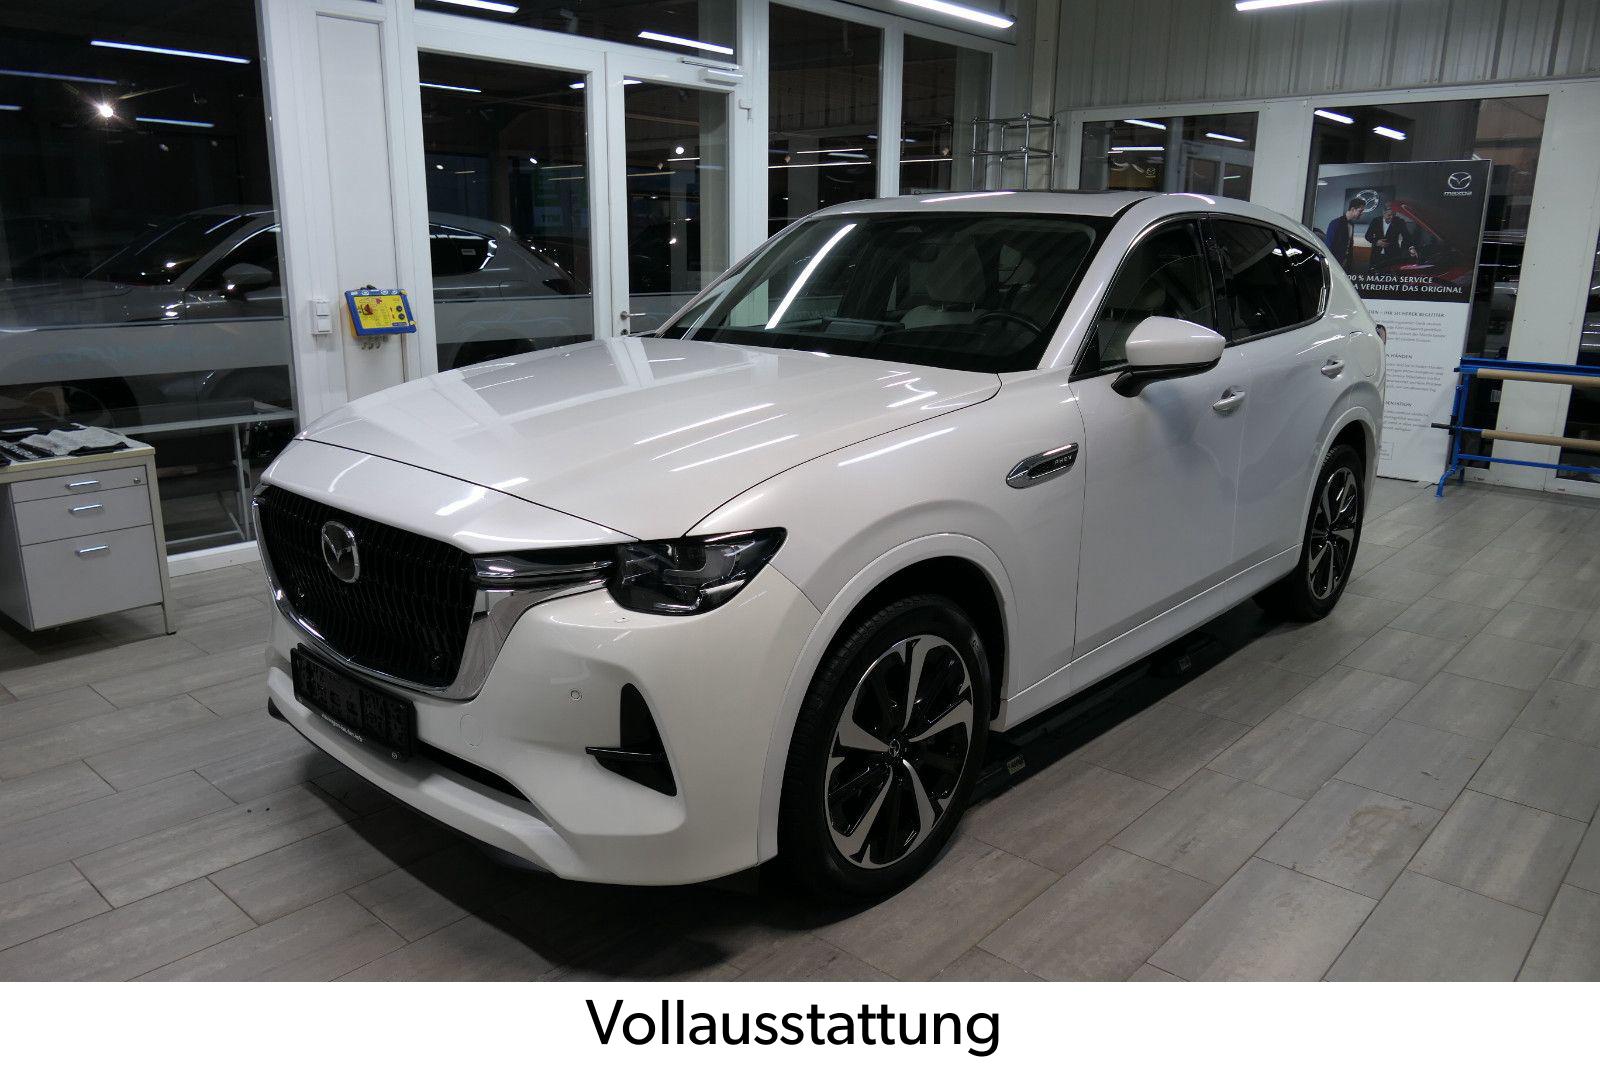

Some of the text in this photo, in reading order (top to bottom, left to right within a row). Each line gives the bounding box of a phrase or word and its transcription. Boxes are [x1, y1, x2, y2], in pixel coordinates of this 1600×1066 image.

[1366, 275, 1398, 283] MAZDA
[1400, 276, 1433, 284] SERVICE
[1361, 284, 1400, 292] VERDIENT
[1421, 285, 1463, 294] ORIGINAL
